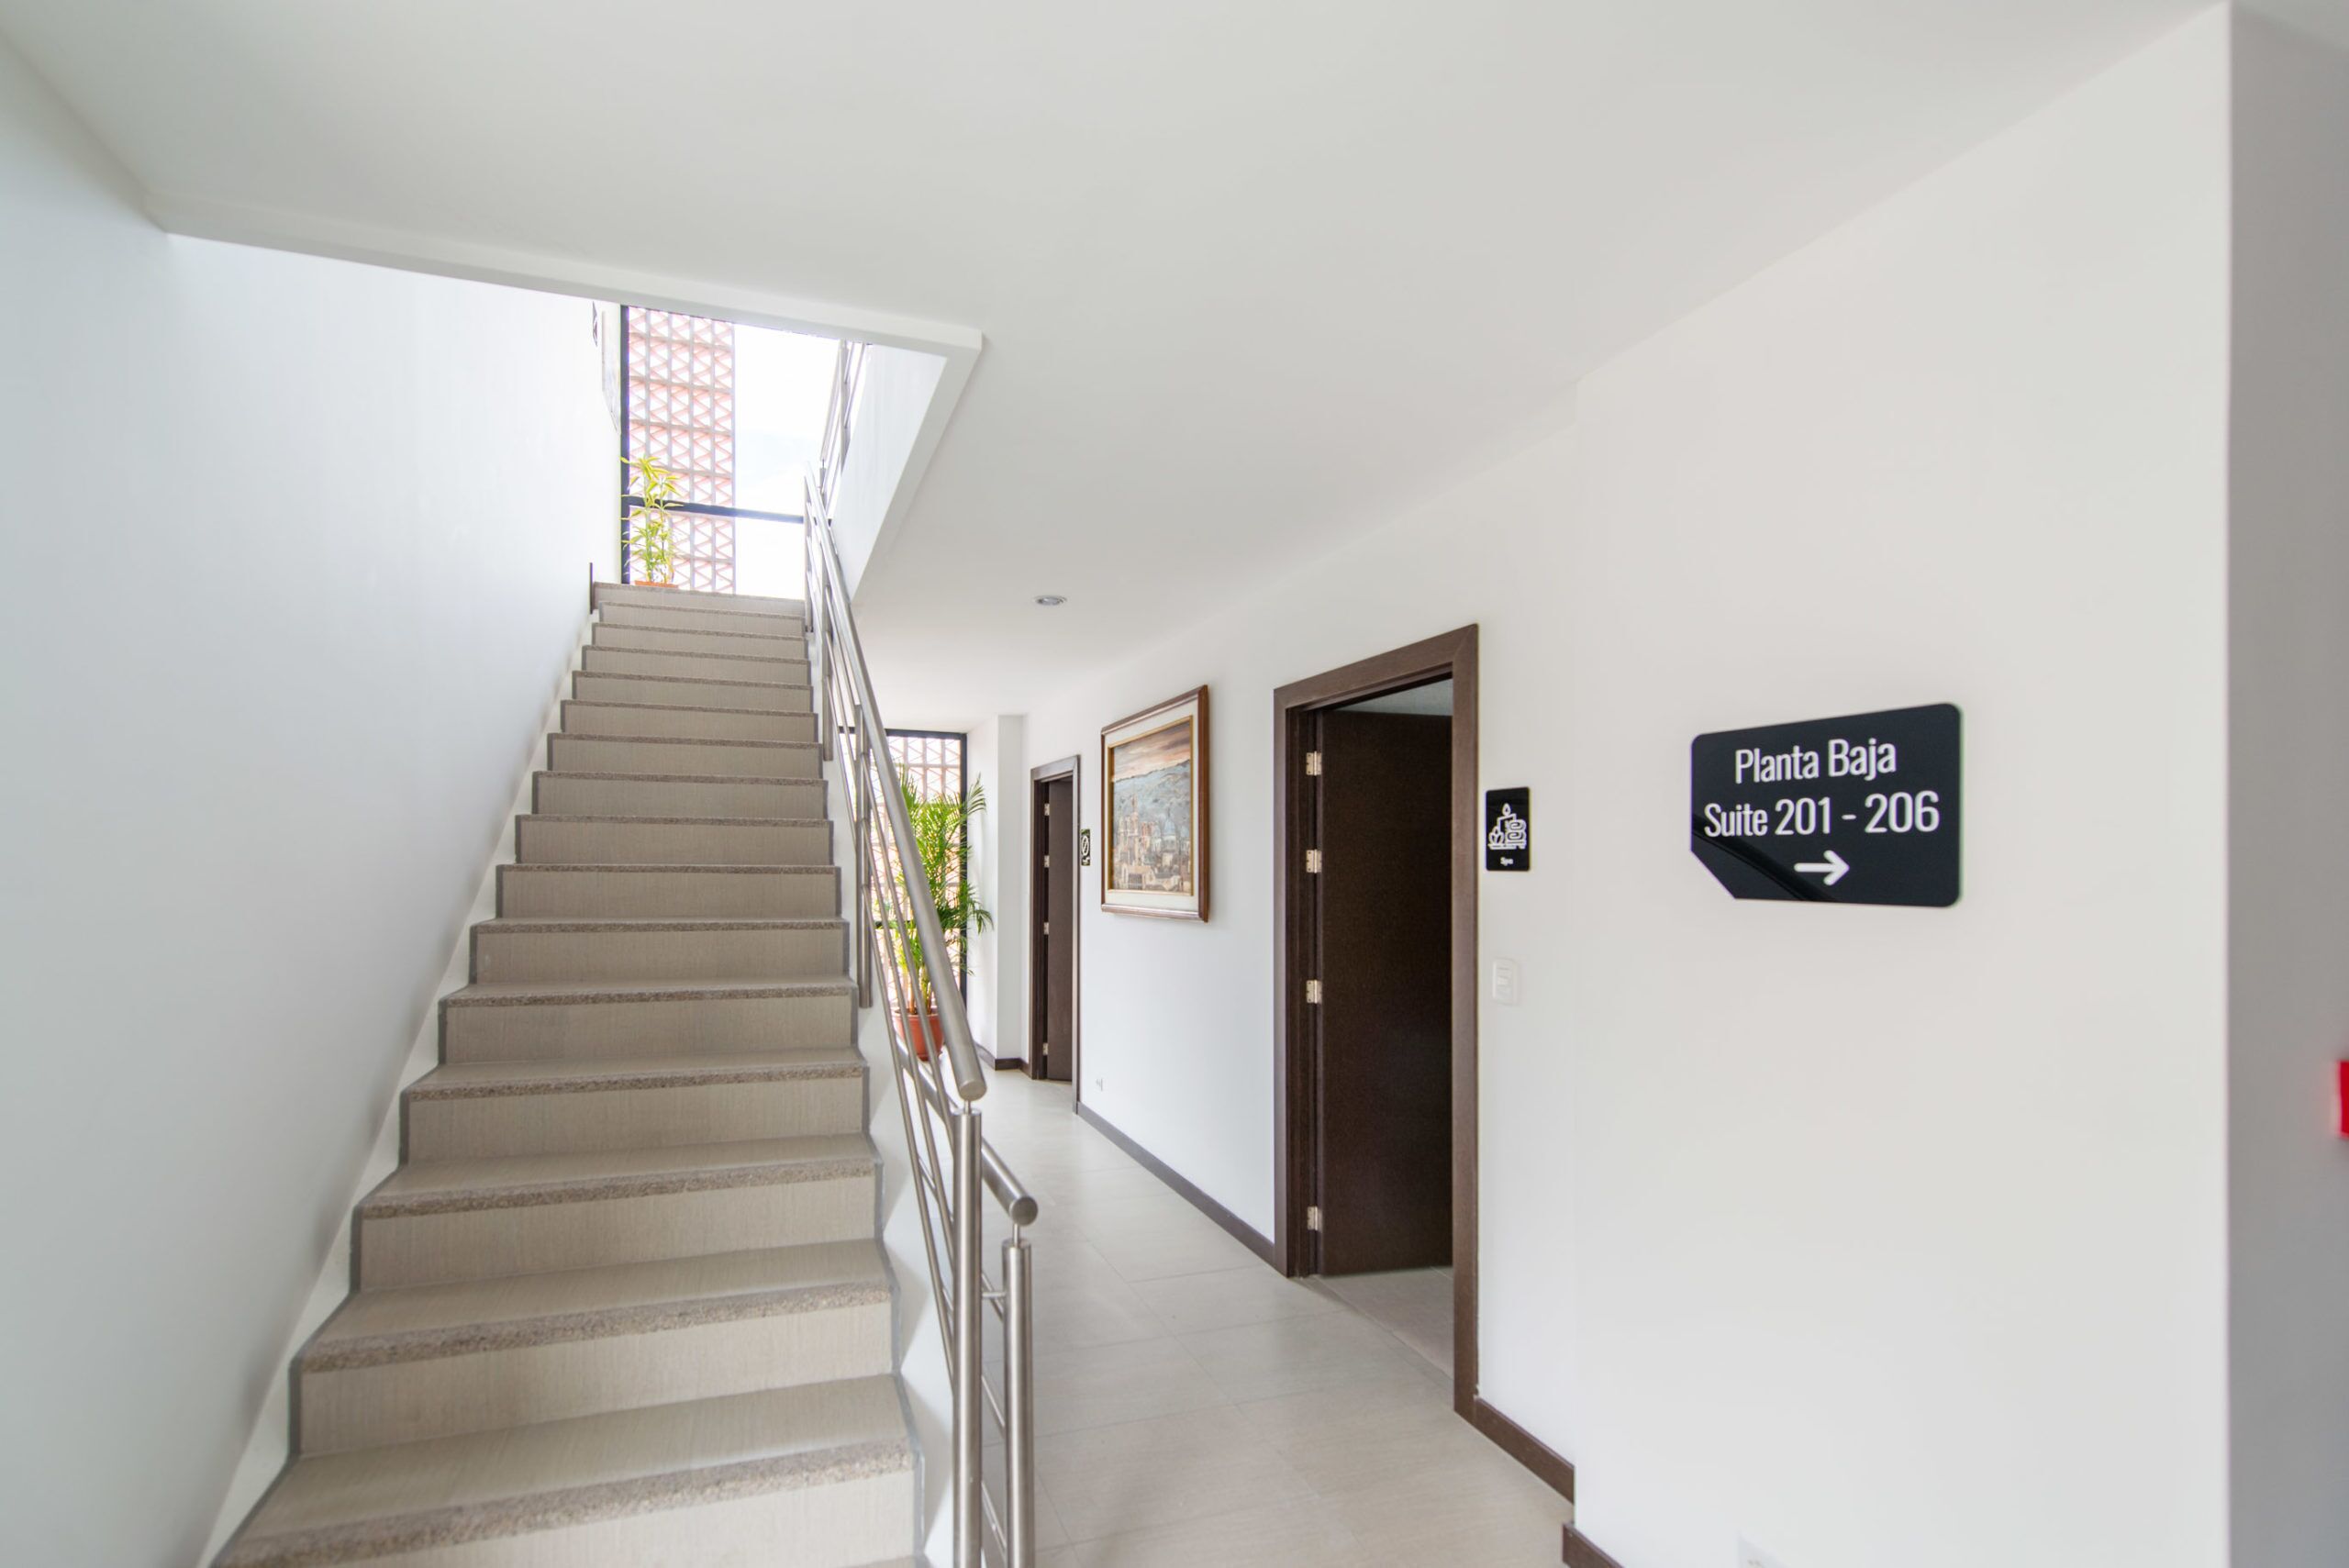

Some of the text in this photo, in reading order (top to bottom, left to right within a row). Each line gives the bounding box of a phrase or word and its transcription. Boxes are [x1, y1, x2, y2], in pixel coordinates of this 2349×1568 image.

[1735, 737, 1897, 784] Planta Baja
[1704, 802, 1768, 838] Suite
[1774, 796, 1831, 836] 201
[1865, 790, 1940, 834] 206
